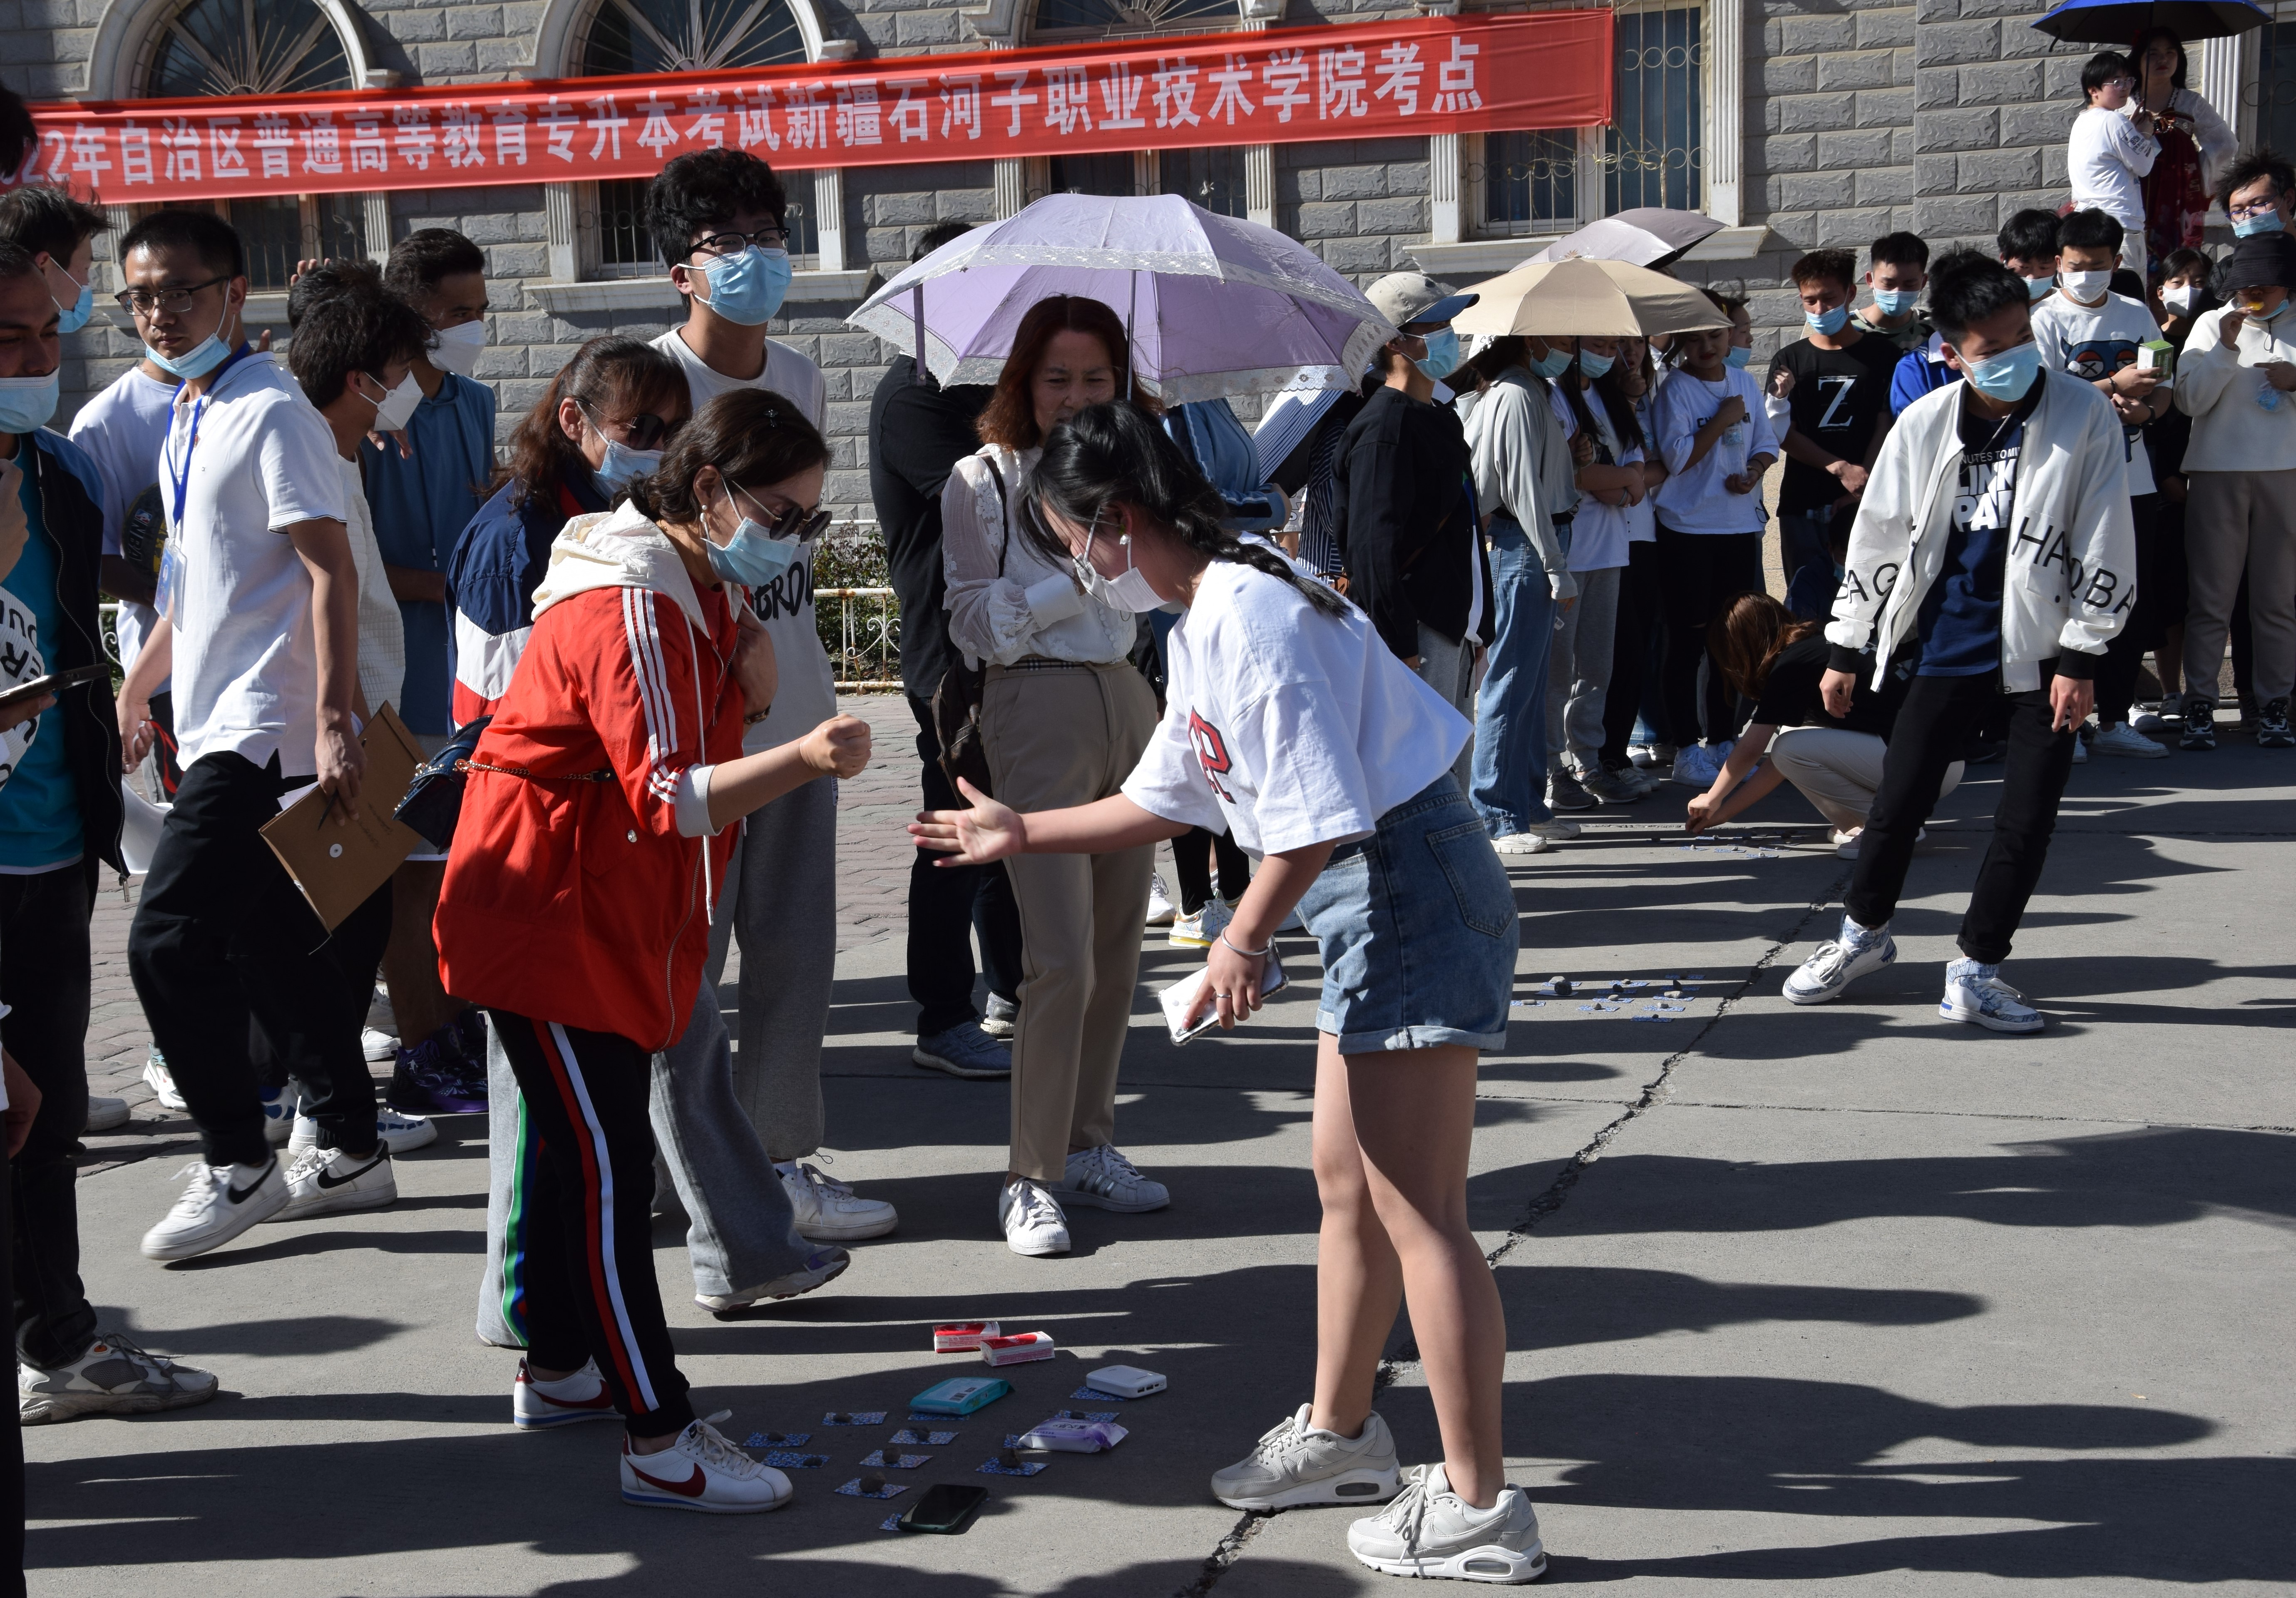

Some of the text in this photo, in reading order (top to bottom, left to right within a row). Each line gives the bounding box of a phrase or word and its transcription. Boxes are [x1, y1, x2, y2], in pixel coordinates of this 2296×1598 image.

[0, 35, 1483, 187] 22年自治区普通高等教育专升本考试新疆石河子职业技术学院考点
[1818, 379, 1856, 427] Z
[127, 518, 148, 561] NBA
